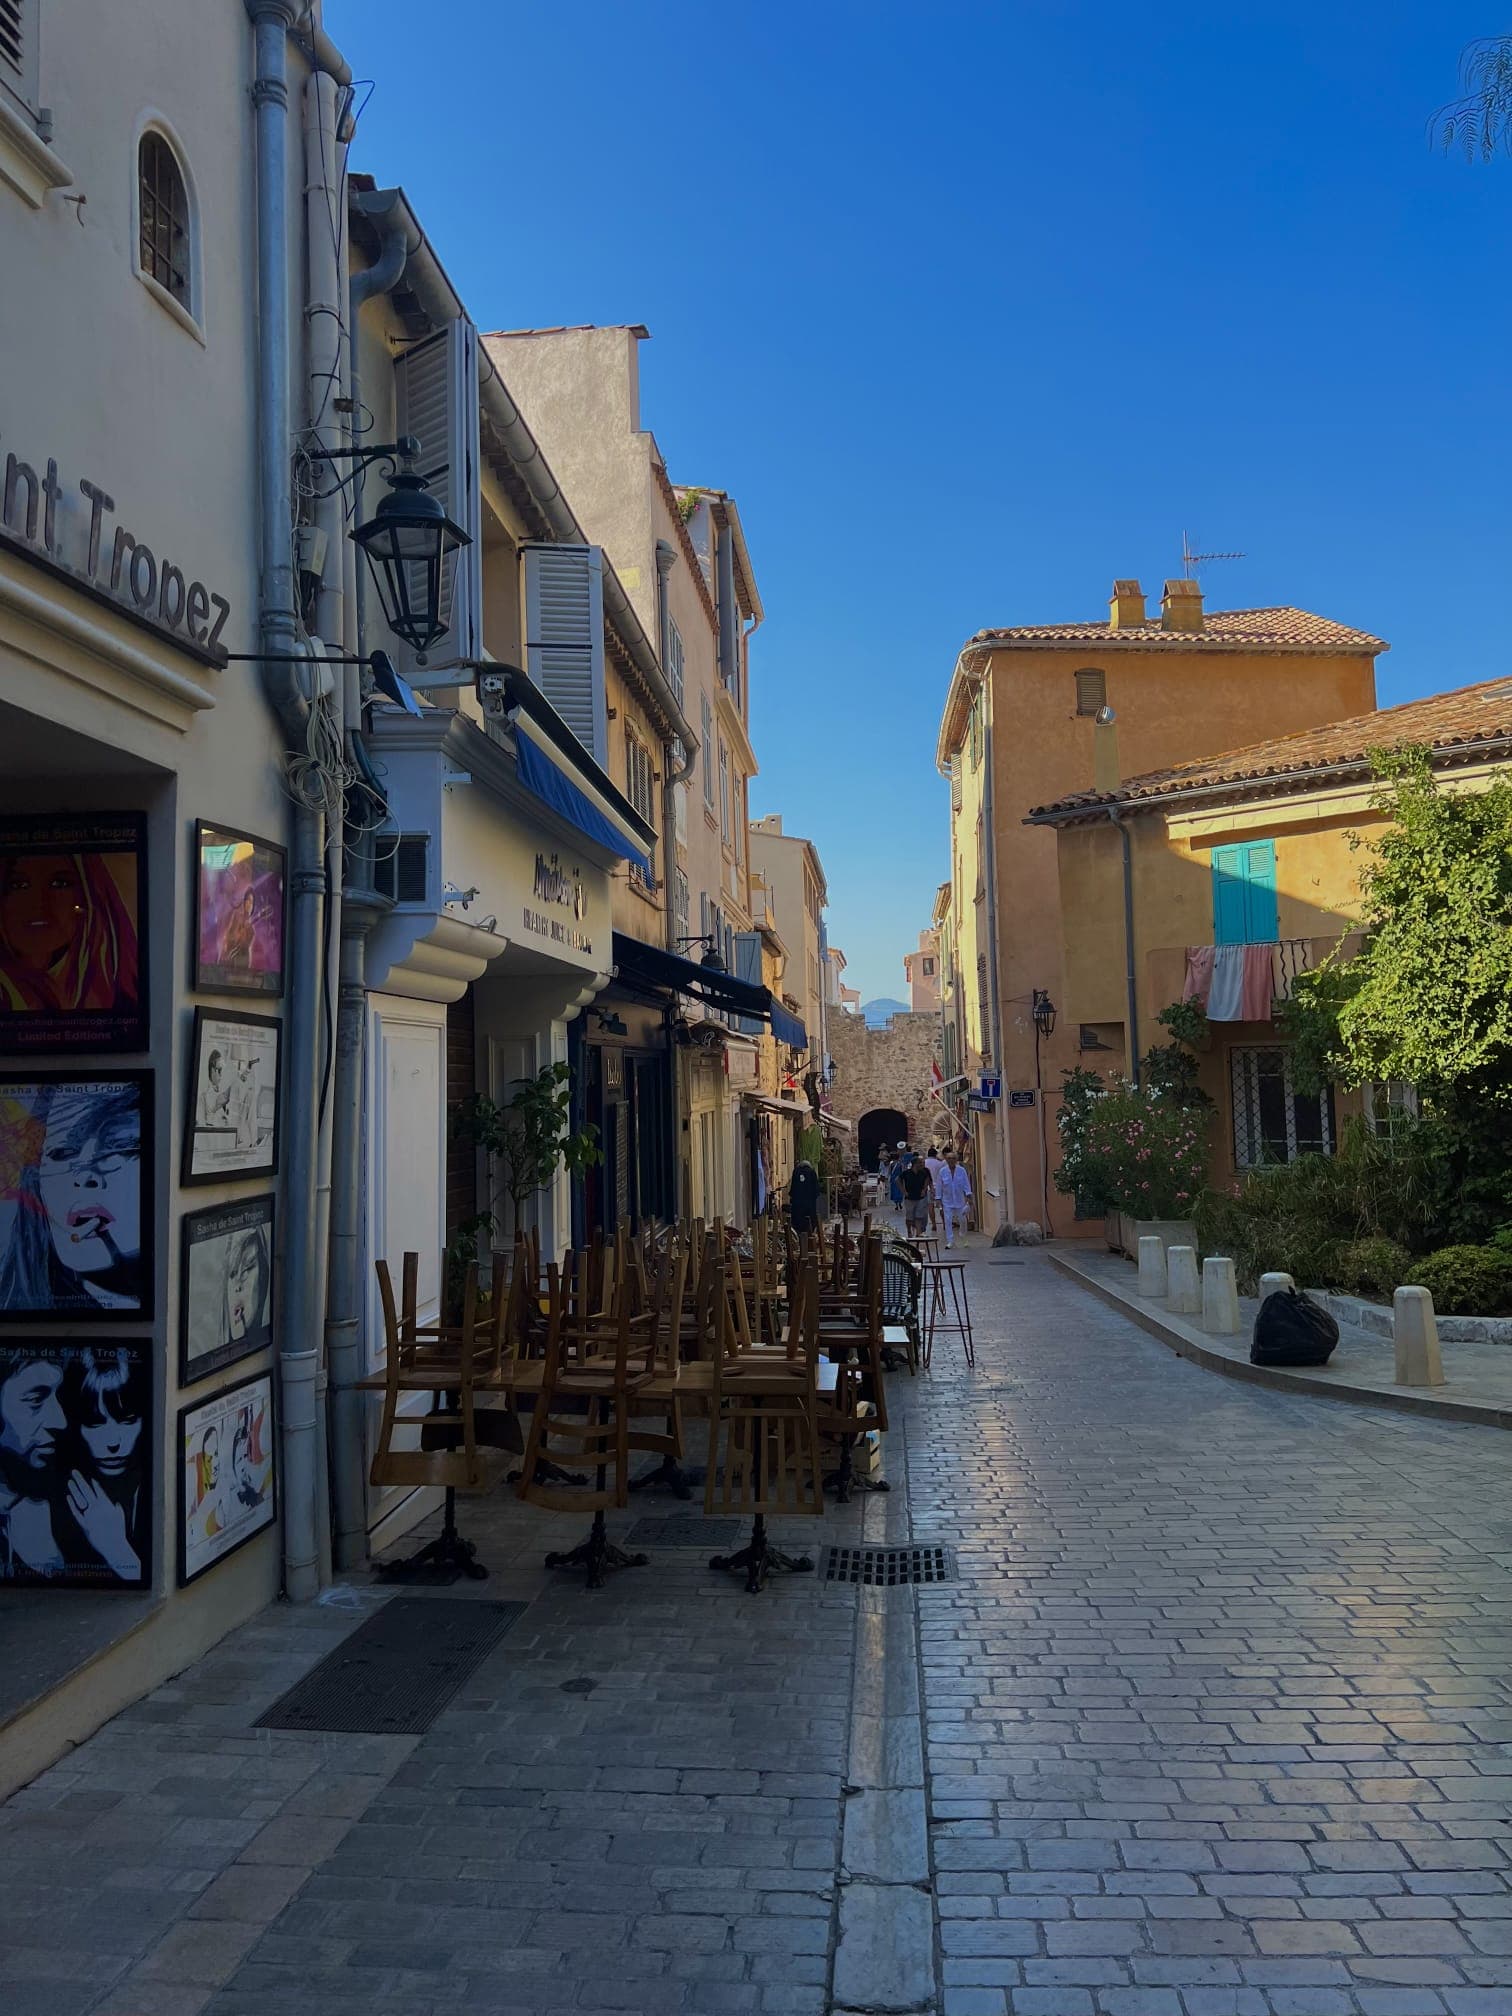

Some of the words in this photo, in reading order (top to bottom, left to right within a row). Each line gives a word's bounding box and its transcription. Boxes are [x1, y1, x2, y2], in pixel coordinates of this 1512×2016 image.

[79, 478, 231, 655] Tropez
[17, 1031, 61, 1041] Limited
[64, 1030, 112, 1041] Editions
[56, 1084, 88, 1094] Saint
[196, 1221, 217, 1235] Sasha
[218, 1218, 227, 1230] de
[227, 1213, 243, 1228] Saint
[40, 1348, 57, 1358] de
